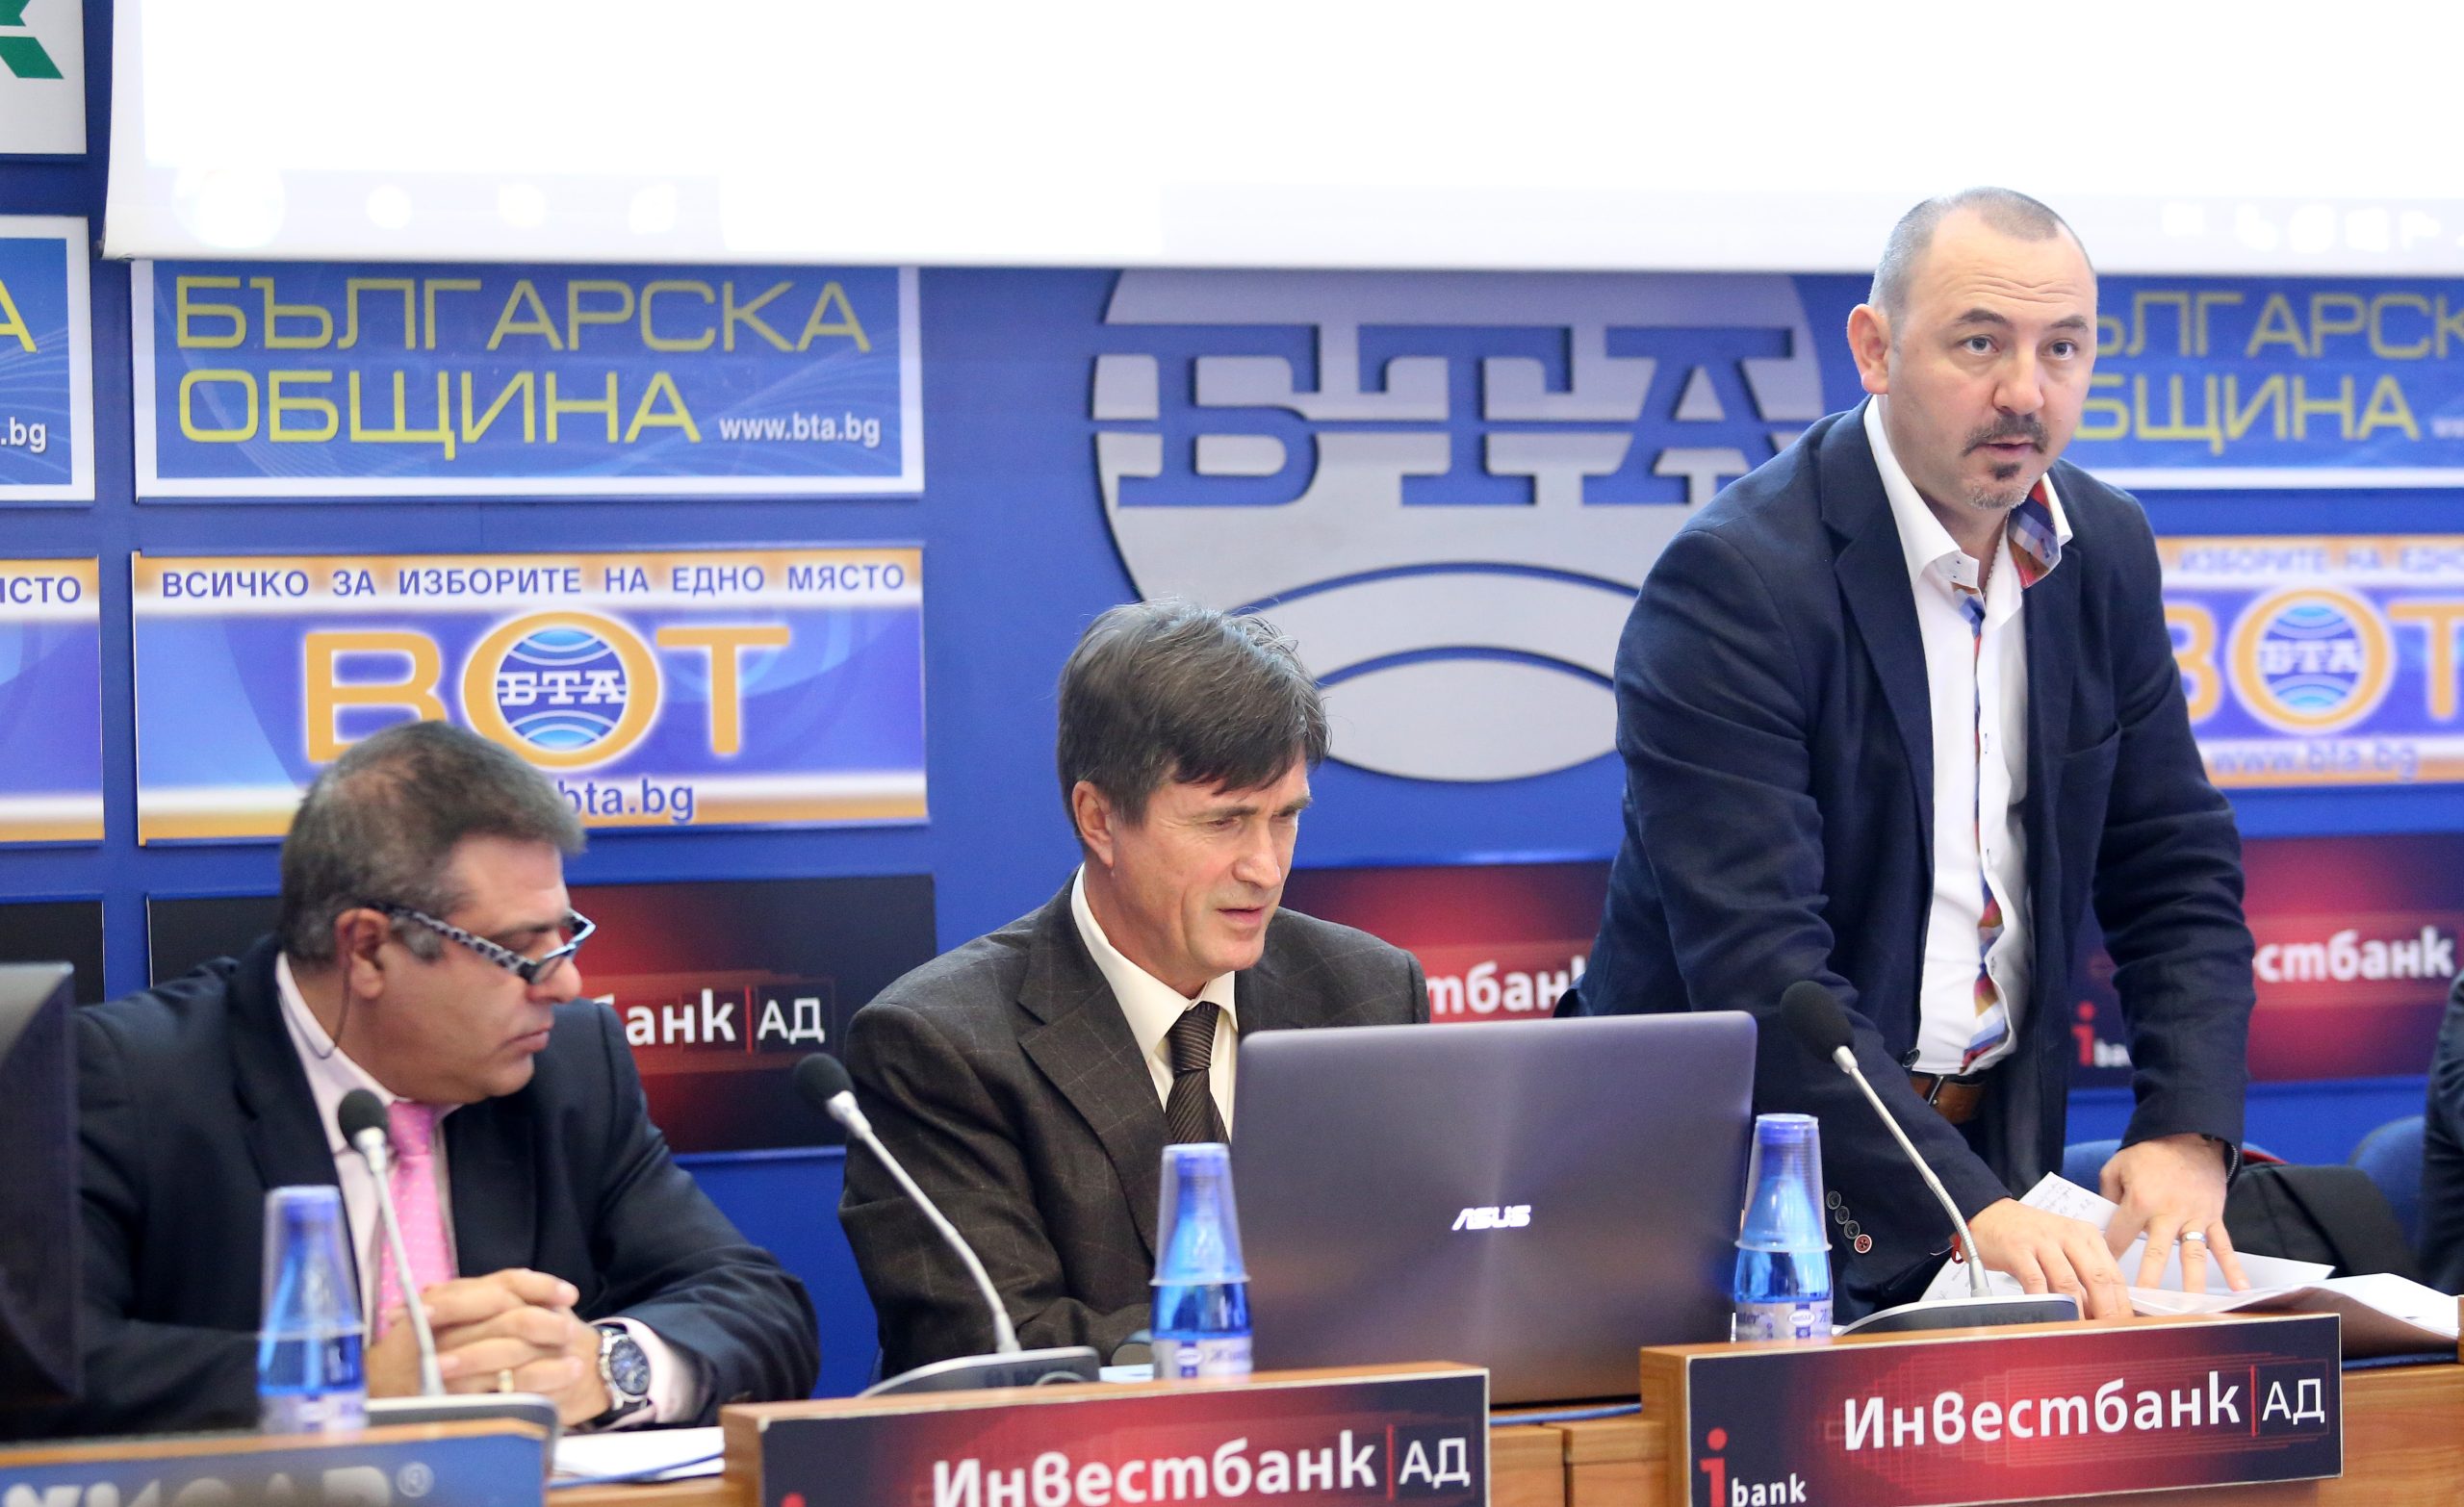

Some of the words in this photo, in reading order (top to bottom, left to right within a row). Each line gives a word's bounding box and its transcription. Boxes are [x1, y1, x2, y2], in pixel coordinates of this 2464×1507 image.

[176, 276, 871, 352] БЪЛГАРСКА
[179, 369, 702, 460] ОБЩИНА
[719, 413, 881, 447] www.bta.bg
[1113, 323, 1794, 506] БТА
[0, 575, 82, 603] СТО
[162, 570, 309, 598] ВСИЧКО
[332, 570, 376, 597] ЗА
[398, 568, 581, 596] ИЗБОРИТЕ
[604, 567, 650, 593] НА
[672, 566, 764, 596] ЕДНО
[787, 564, 905, 591] МЯСТО
[304, 610, 790, 768] ВОТ
[498, 670, 628, 706] БТА
[2253, 926, 2456, 983] стбанк
[757, 997, 826, 1046] АД
[1451, 1204, 1531, 1231] ASUS
[1844, 1371, 2241, 1451] Инвестбанк
[2261, 1378, 2325, 1425] АД
[1399, 1438, 1471, 1487] АД
